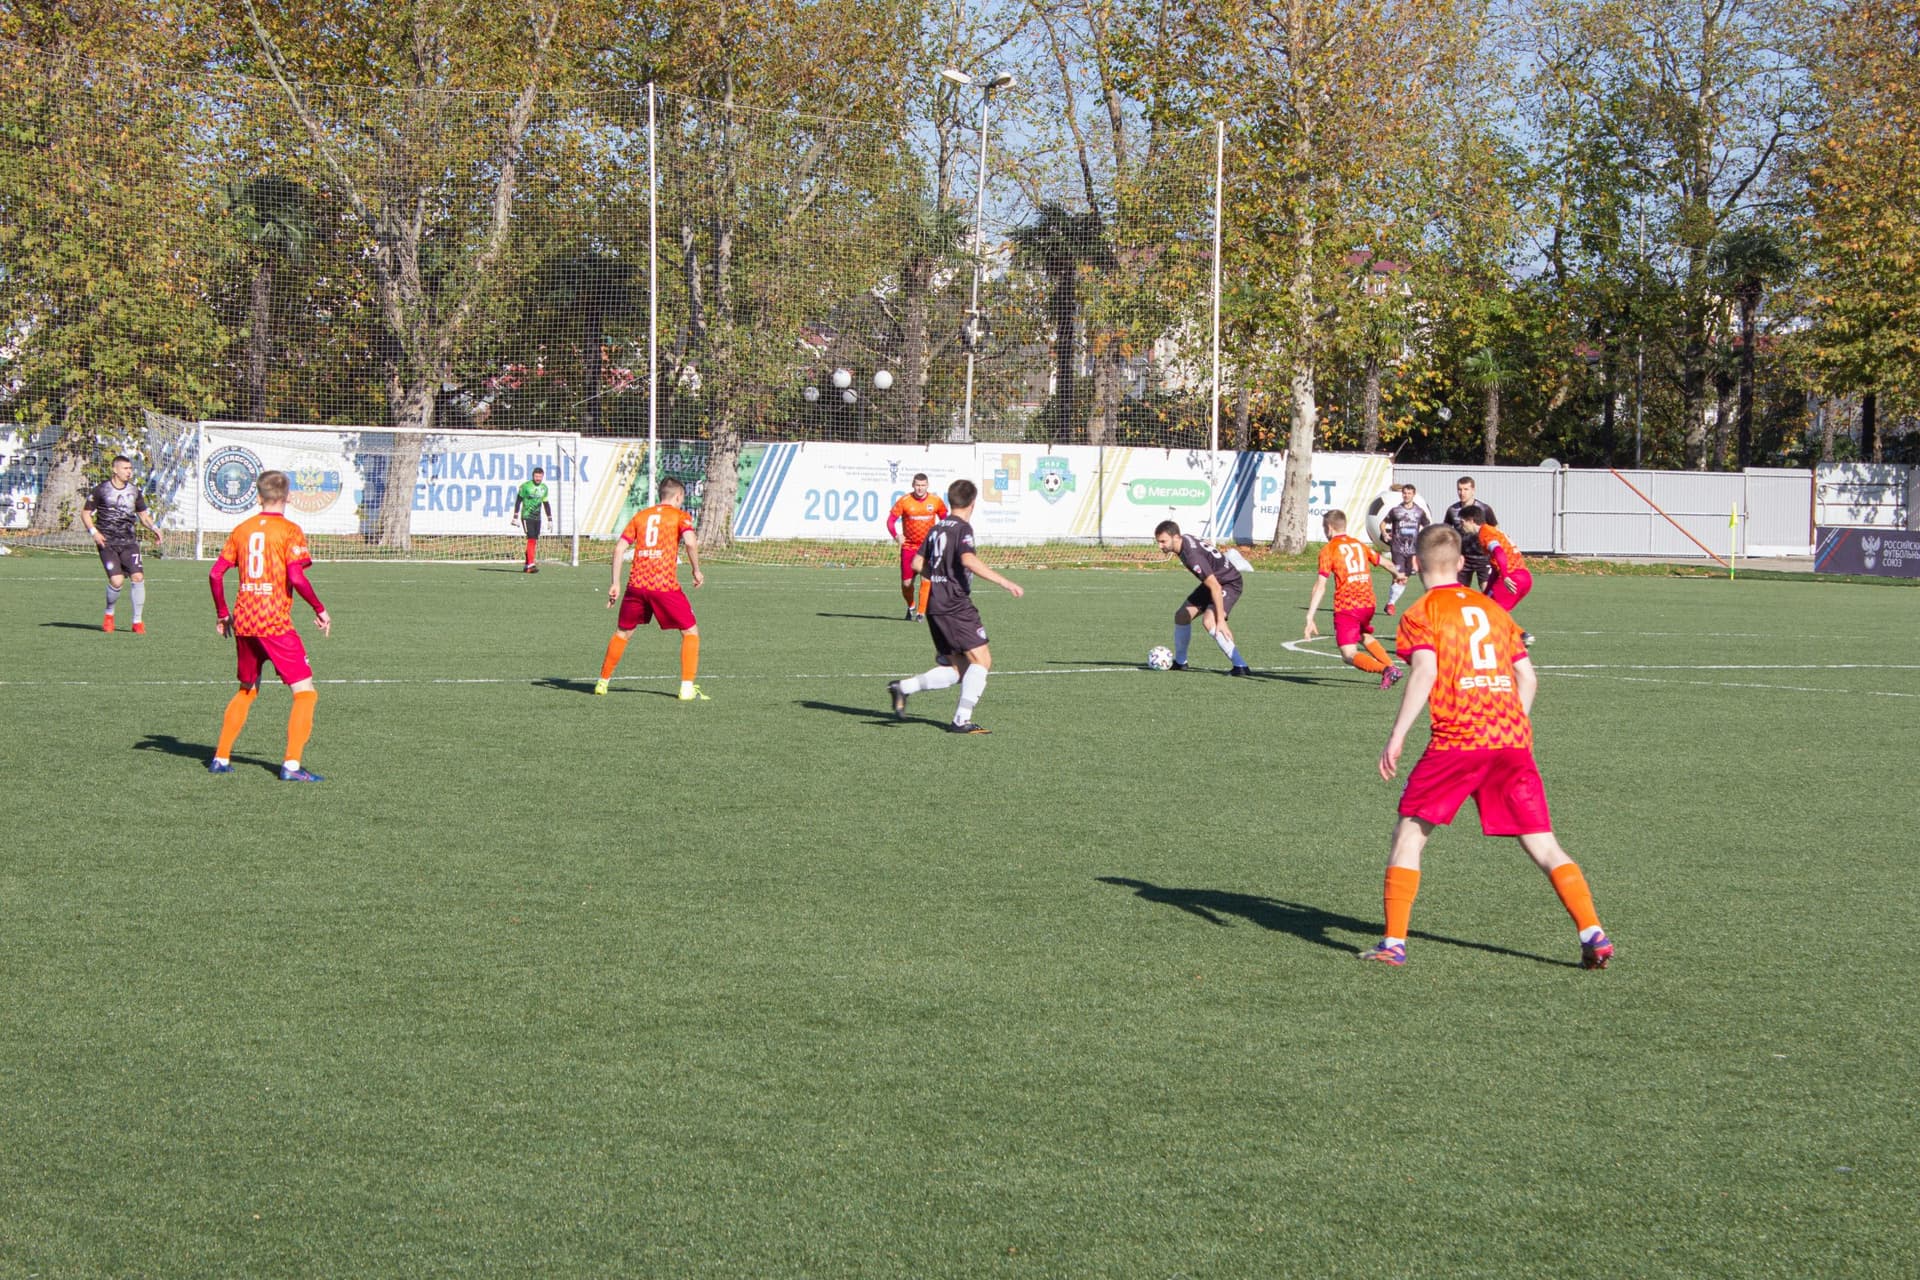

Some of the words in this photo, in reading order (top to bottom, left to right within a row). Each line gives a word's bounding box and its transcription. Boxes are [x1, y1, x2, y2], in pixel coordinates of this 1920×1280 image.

[804, 488, 879, 522] 2020
[645, 514, 661, 547] 6
[248, 532, 265, 578] 8
[1199, 541, 1222, 559] 8
[1338, 542, 1366, 574] 27
[1461, 606, 1497, 669] 2
[1460, 675, 1511, 689] SEUS
